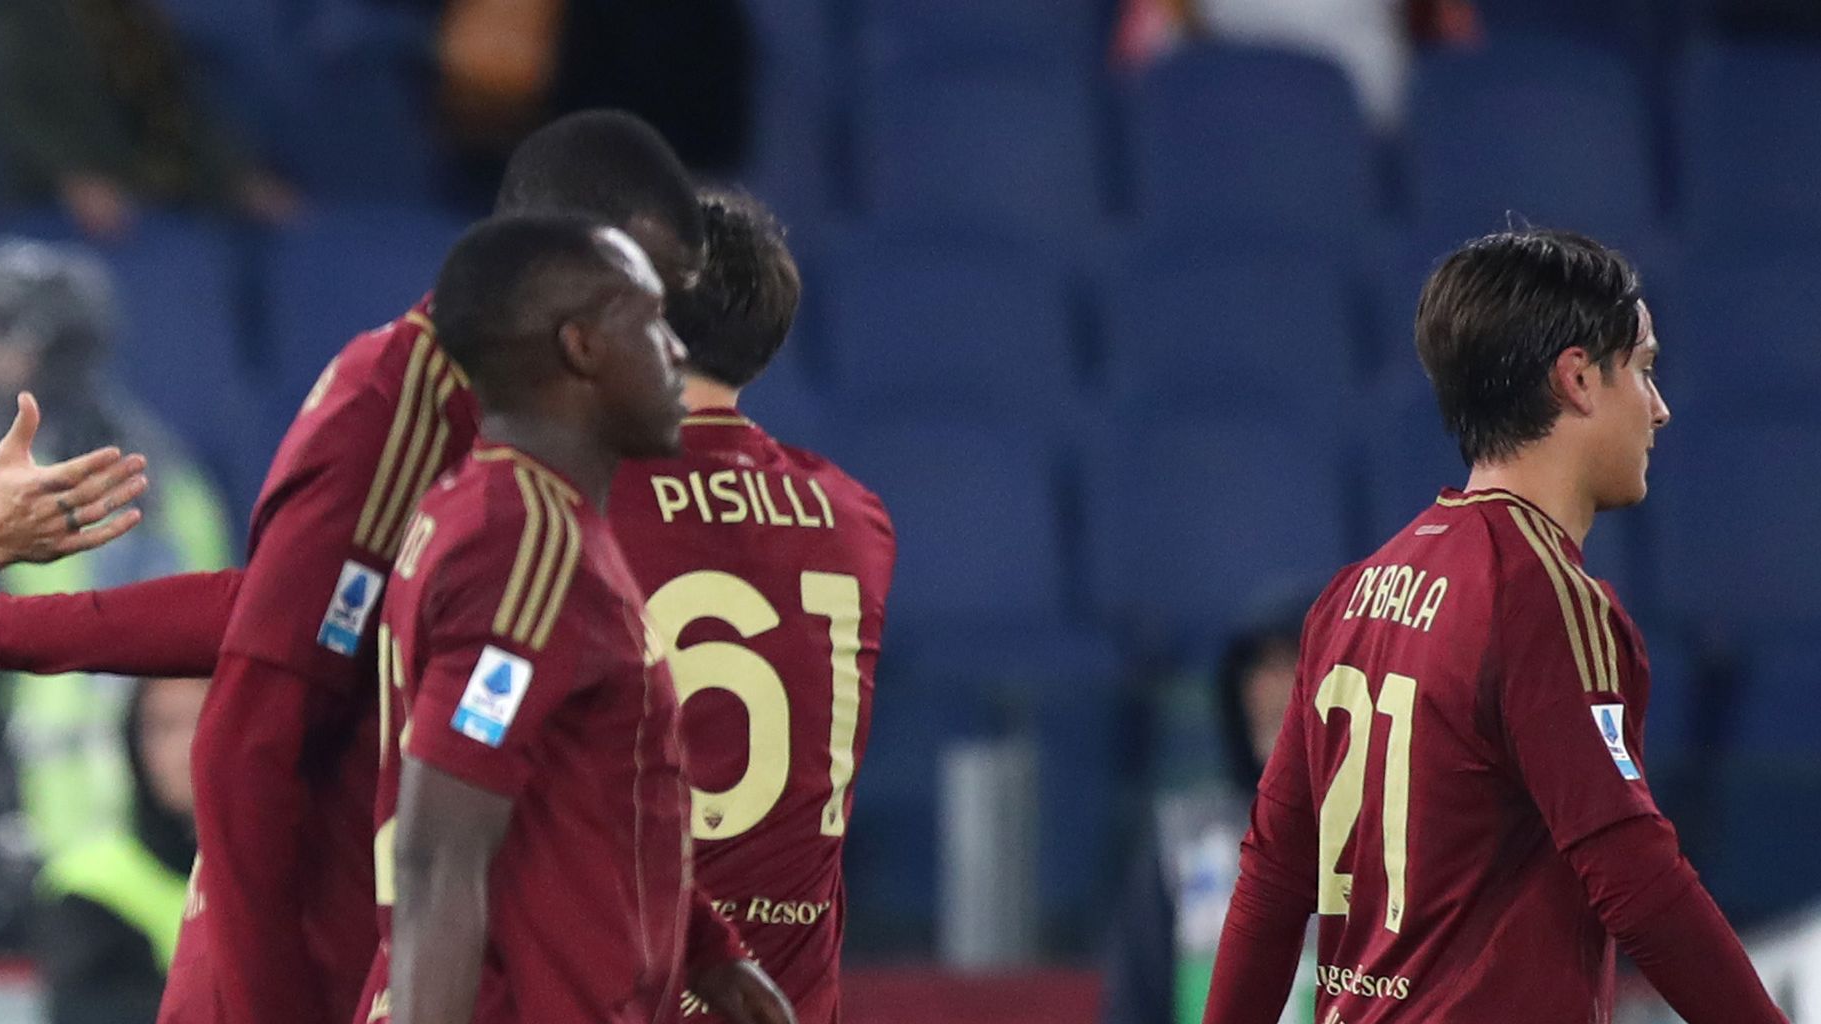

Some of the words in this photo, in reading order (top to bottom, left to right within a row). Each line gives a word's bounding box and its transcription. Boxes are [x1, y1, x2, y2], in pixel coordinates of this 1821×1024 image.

[650, 470, 836, 530] PISILLI
[644, 569, 862, 839] 61
[1314, 663, 1418, 935] 21
